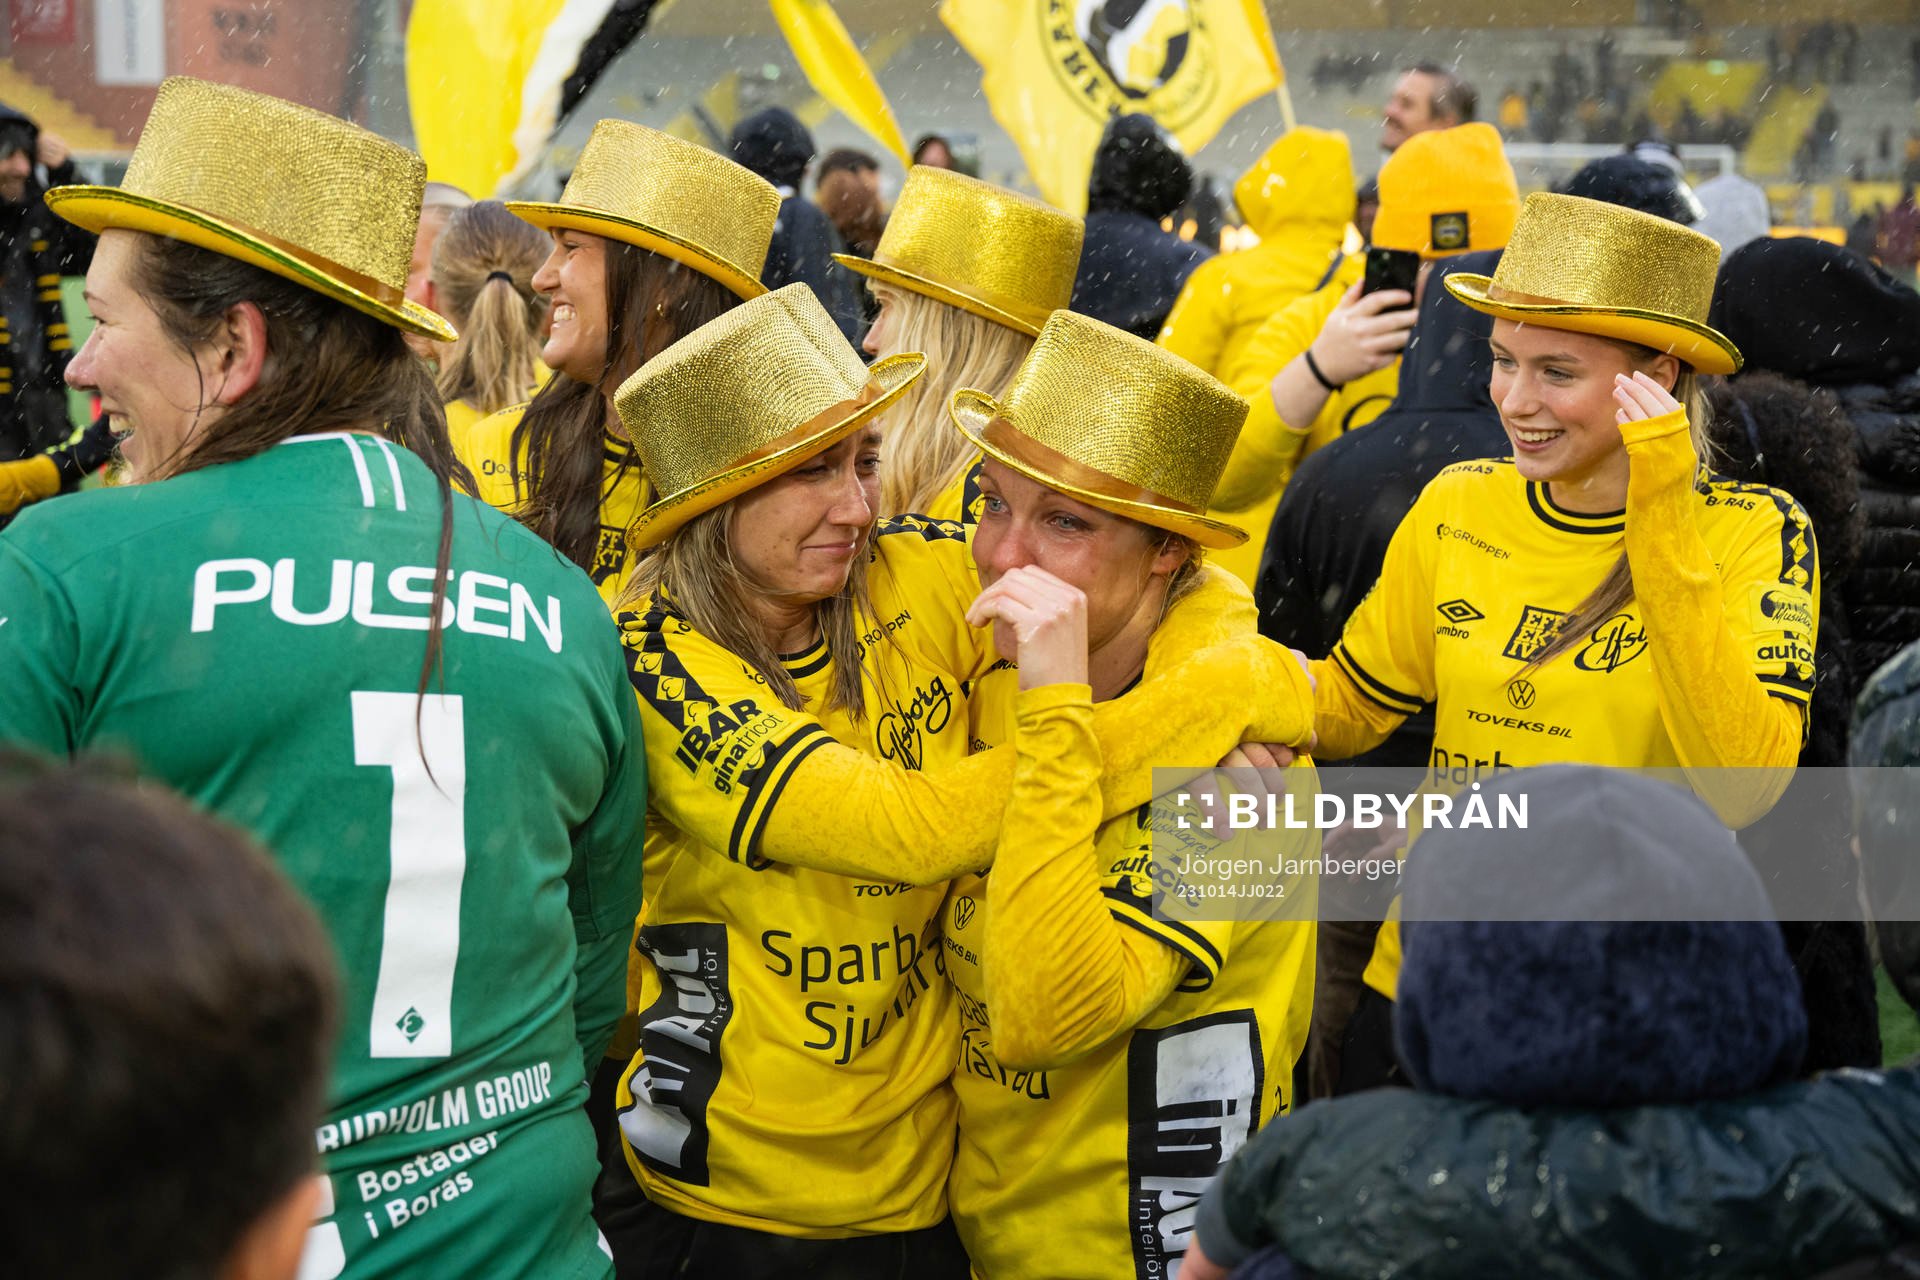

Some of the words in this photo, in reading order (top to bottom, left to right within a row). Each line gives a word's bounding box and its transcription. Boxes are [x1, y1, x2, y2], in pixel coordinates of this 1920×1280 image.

[190, 558, 563, 654] PULSEN
[1436, 625, 1470, 640] umbro
[675, 698, 763, 774] IBAR
[714, 713, 784, 795] ginatricot
[1466, 709, 1545, 733] TOVEKS
[1547, 726, 1573, 739] BIL
[350, 691, 465, 1058] 1
[475, 1061, 552, 1120] GROUP
[364, 1211, 379, 1239] i
